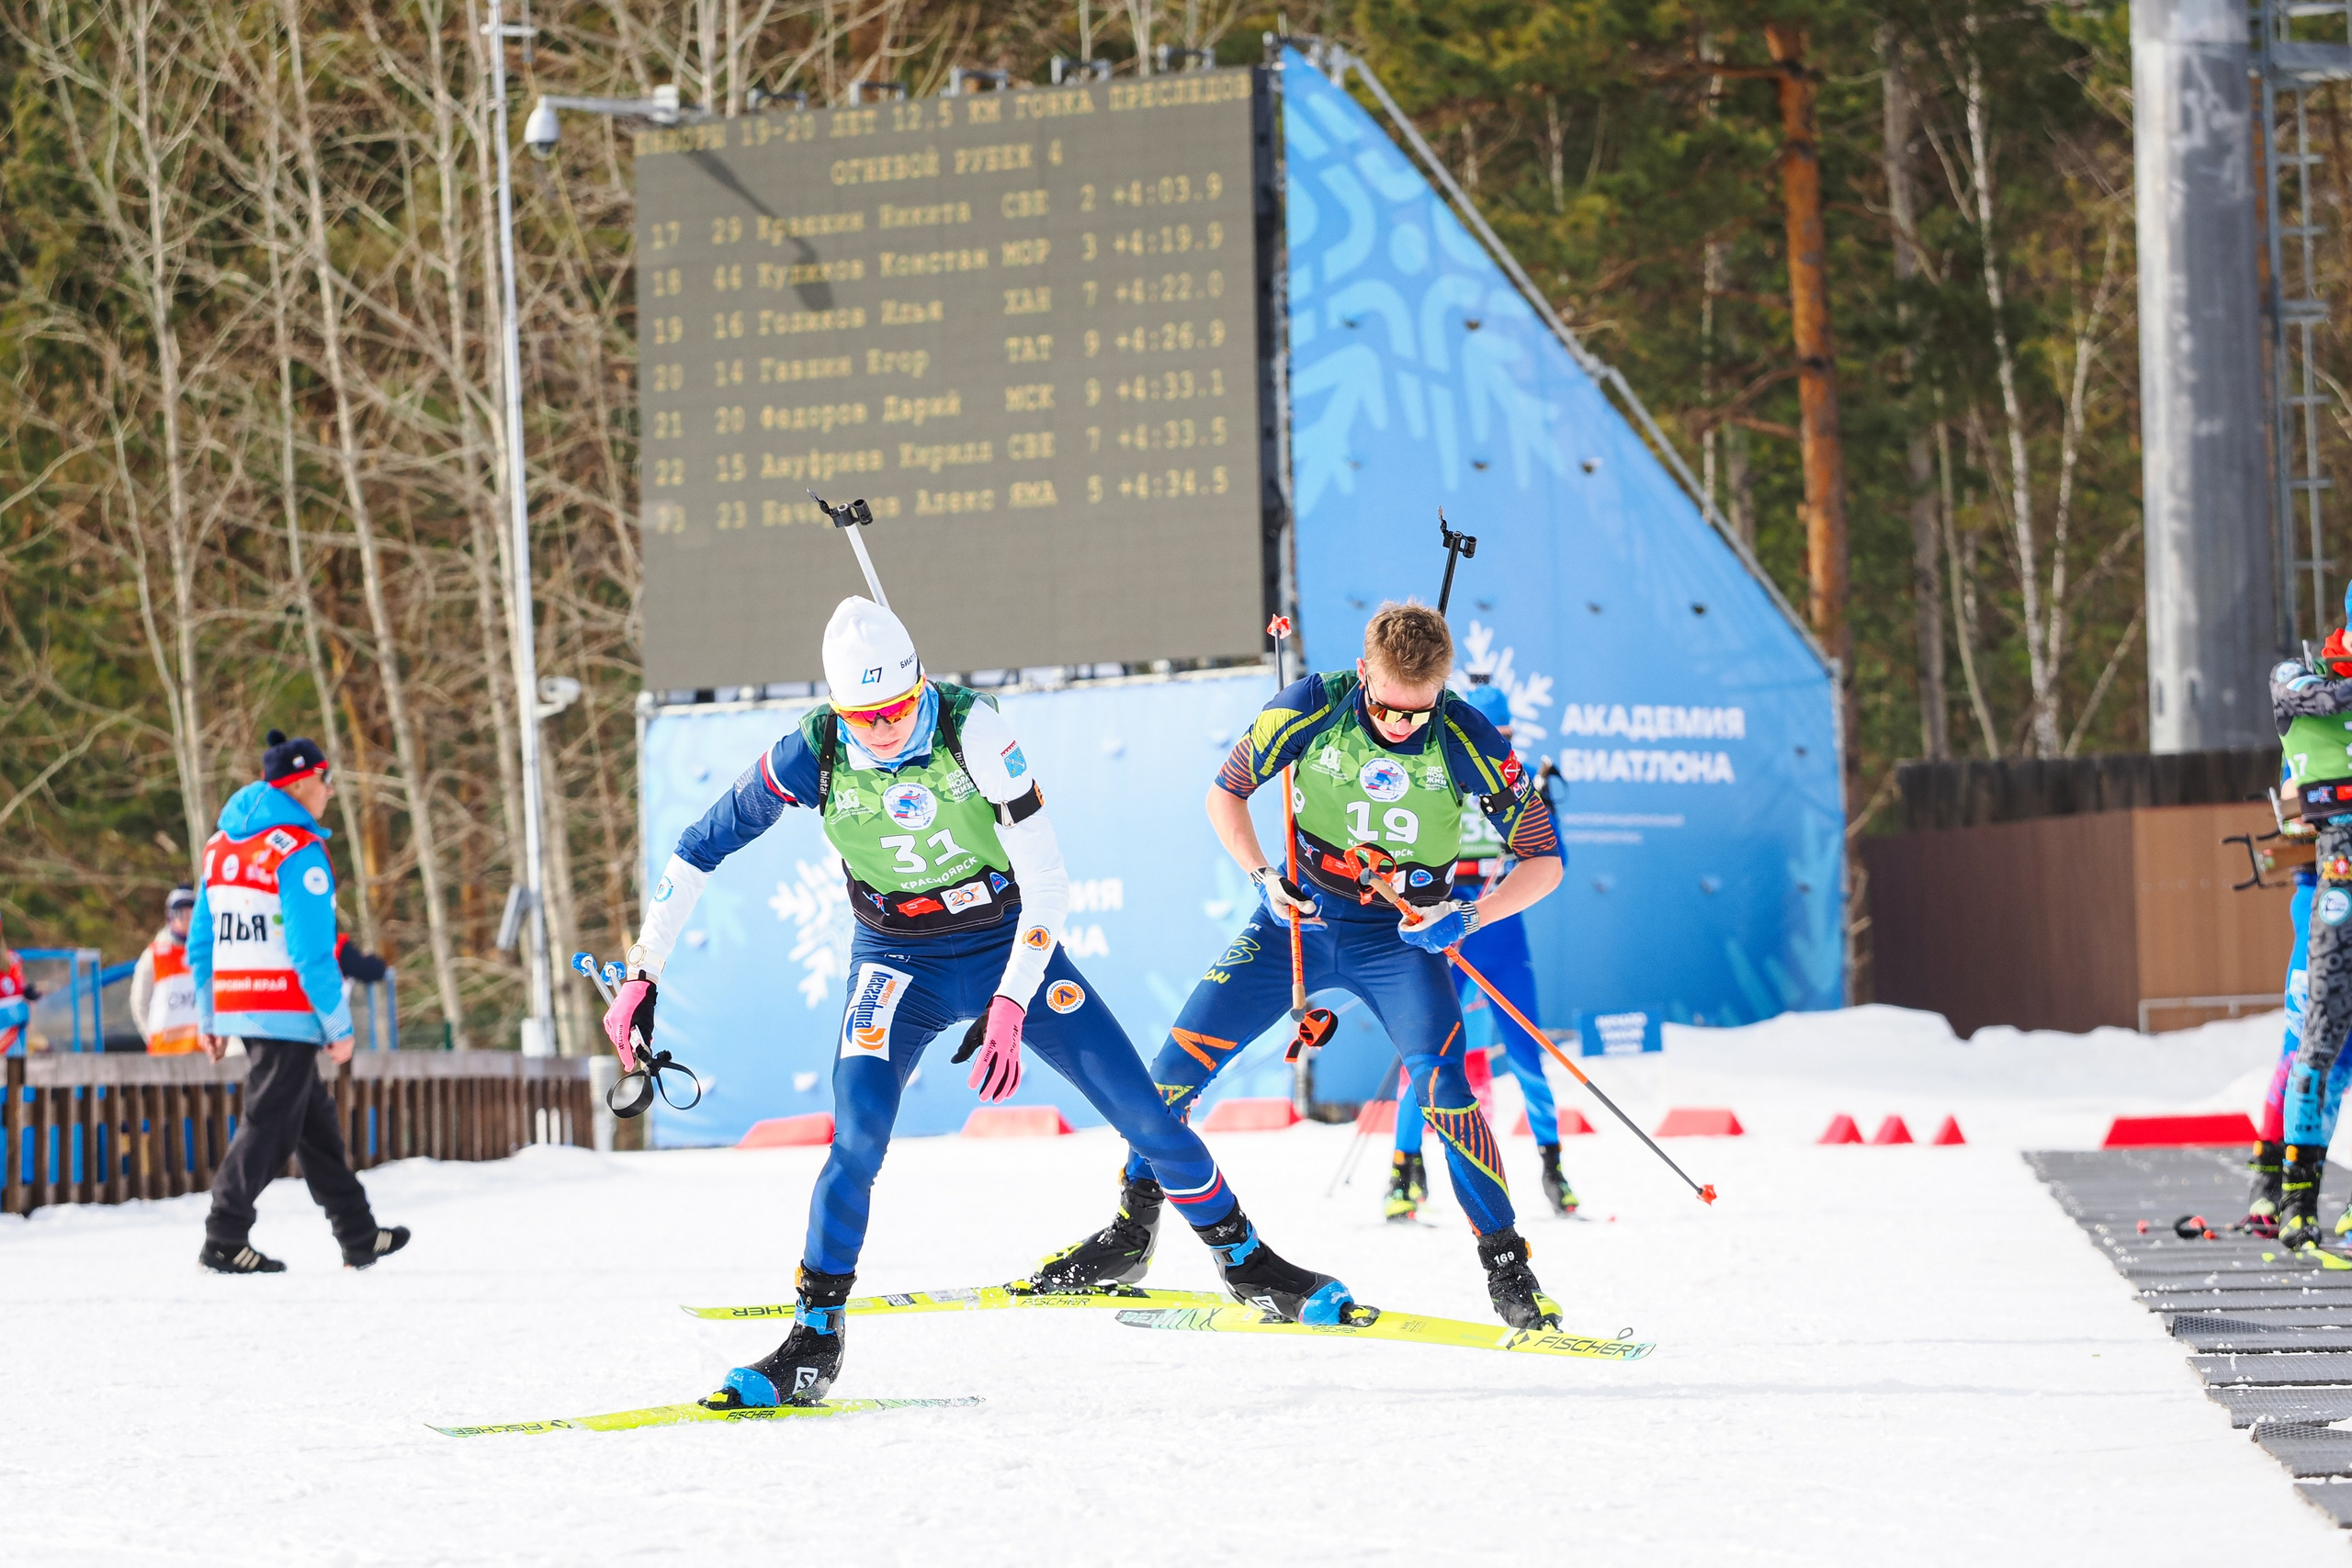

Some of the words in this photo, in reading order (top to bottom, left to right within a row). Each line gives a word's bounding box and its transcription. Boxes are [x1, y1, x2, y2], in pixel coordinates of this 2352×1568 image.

[741, 112, 817, 147] 19-20
[1047, 140, 1063, 166] 4
[651, 220, 681, 250] 17
[711, 216, 742, 245] 29
[1080, 184, 1096, 212] 2
[1112, 172, 1223, 208] +4:03.9
[651, 268, 682, 298] 18
[713, 263, 742, 292] 44
[1081, 231, 1098, 262] 3
[1113, 220, 1224, 256] +4:19.9
[652, 316, 684, 344] 19
[714, 310, 745, 340] 16
[1082, 280, 1098, 309] 7
[1114, 269, 1225, 304] +4:22.0
[652, 364, 684, 392] 20
[714, 359, 745, 388] 14
[1004, 334, 1054, 364] ТАТ
[1084, 329, 1101, 358] 9
[1114, 319, 1226, 354] +4:26.9
[653, 411, 684, 440] 21
[715, 405, 745, 435] 20
[1004, 383, 1055, 412] МСК
[1085, 377, 1102, 407] 9
[1114, 368, 1226, 402] +4:33.1
[654, 458, 685, 487] 22
[716, 453, 747, 483] 15
[1086, 425, 1102, 454] 7
[1116, 416, 1227, 451] +4:33.5
[717, 500, 747, 530] 23
[1087, 474, 1103, 504] 5
[1117, 465, 1229, 501] +4:34.5
[1561, 703, 1746, 742] АКАДЕМИЯ
[1561, 748, 1736, 784] БИАТЛОНА
[1346, 800, 1420, 845] 19
[878, 828, 973, 874] 31
[899, 855, 978, 891] КРАСНОЯРСК
[218, 911, 268, 946] ДЬЯ
[1493, 1250, 1516, 1264] 169
[730, 1304, 796, 1317] CHER
[1311, 1325, 1359, 1335] FISCHER
[1533, 1336, 1636, 1358] FISCHER
[726, 1409, 776, 1421] FISCHER
